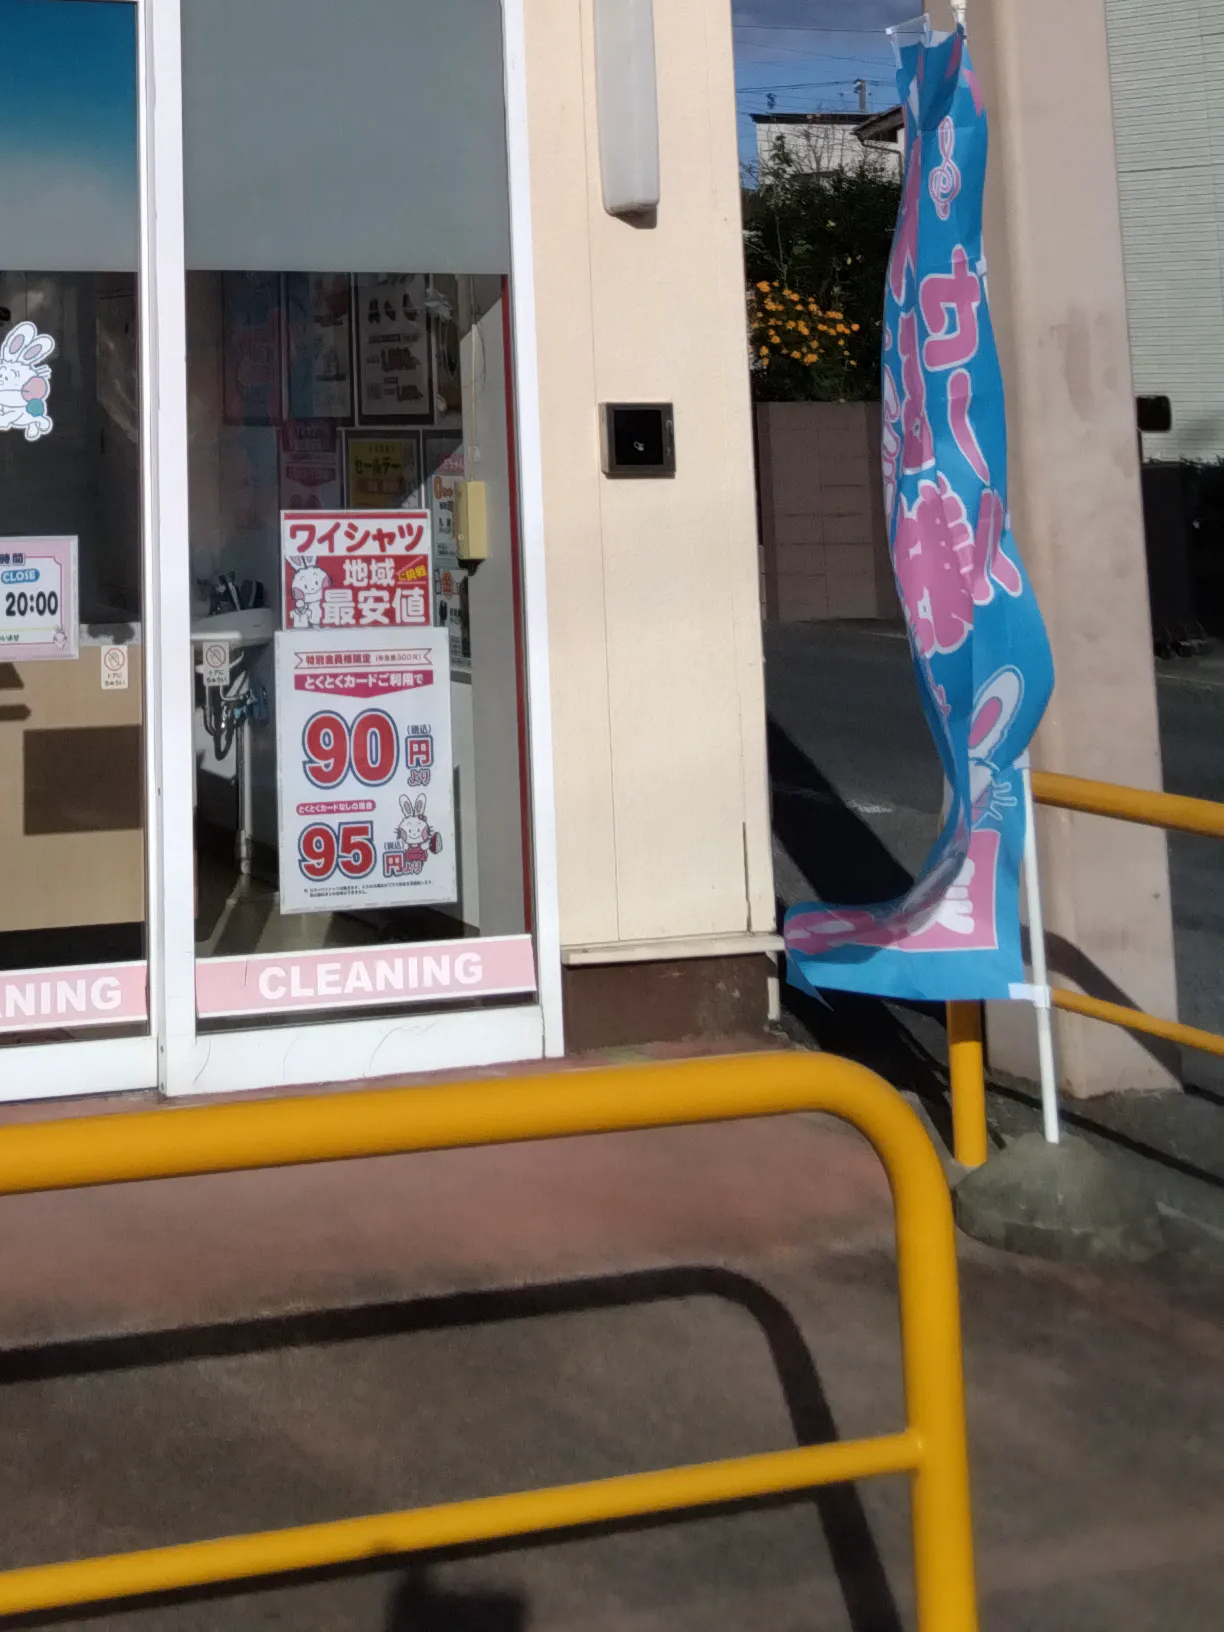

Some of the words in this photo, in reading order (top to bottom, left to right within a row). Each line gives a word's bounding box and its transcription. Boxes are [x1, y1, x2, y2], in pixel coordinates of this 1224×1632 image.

[289, 522, 424, 553] ワイシャツ
[3, 570, 36, 583] CLOSE
[343, 558, 395, 587] 地域
[5, 591, 58, 617] 20:00
[322, 587, 426, 625] 最安値
[305, 673, 424, 689] とくとくカードご利用で
[302, 708, 399, 790] 90
[405, 735, 433, 769] 円
[407, 769, 431, 786] より
[298, 820, 377, 882] 95
[258, 953, 483, 1000] CLEANING
